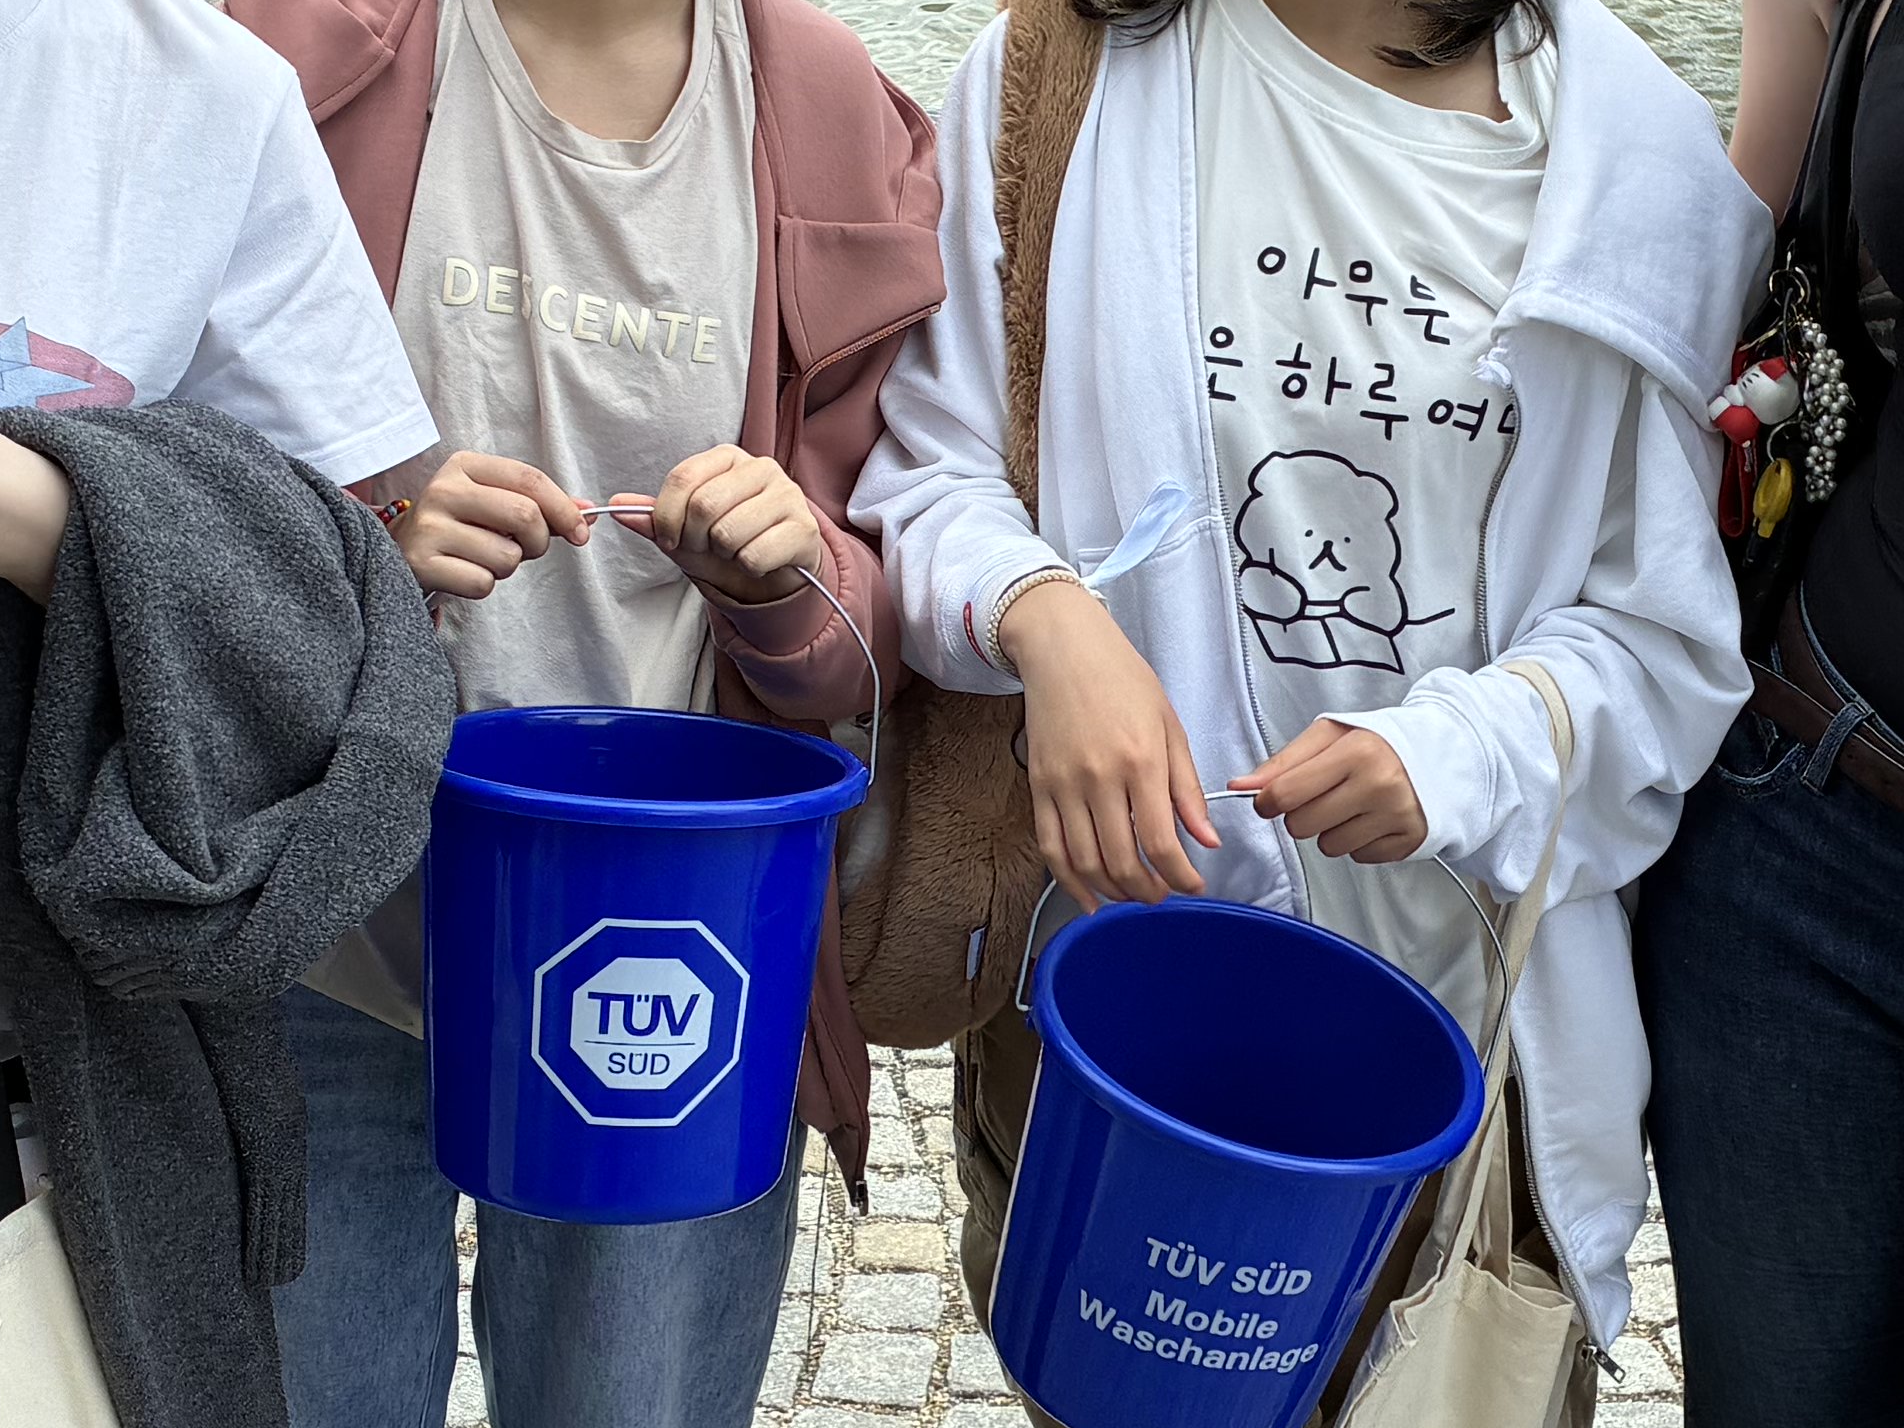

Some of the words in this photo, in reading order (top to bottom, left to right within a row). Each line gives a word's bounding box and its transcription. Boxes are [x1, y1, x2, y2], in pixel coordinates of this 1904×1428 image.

[587, 991, 700, 1036] TÜV
[607, 1052, 670, 1076] SÜD
[1146, 1237, 1225, 1286] TÜV
[1231, 1262, 1312, 1296] SÜD
[1079, 1288, 1319, 1374] Waschanlage
[1144, 1289, 1279, 1339] Mobile
